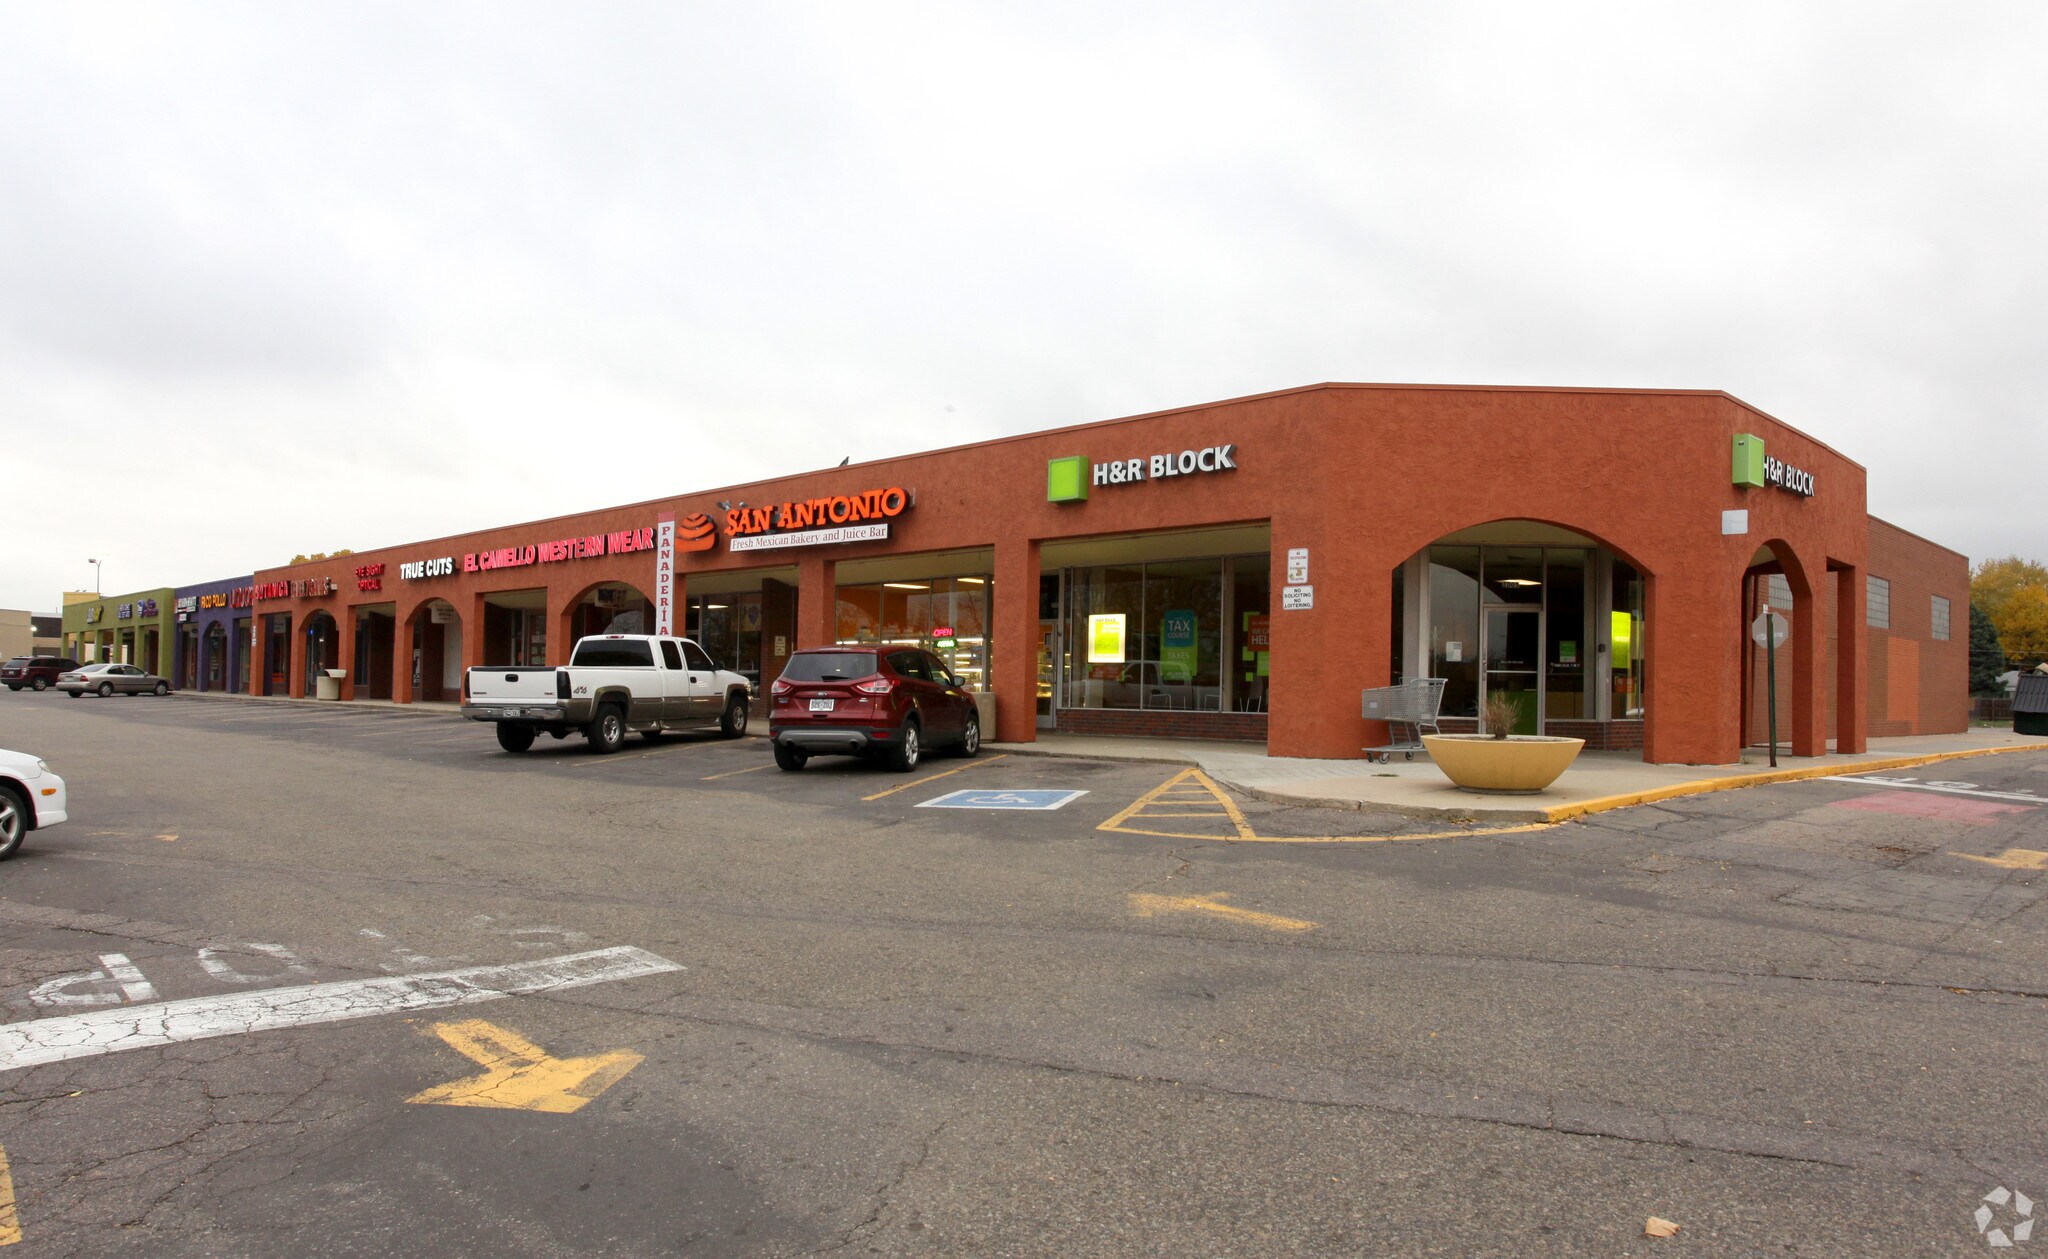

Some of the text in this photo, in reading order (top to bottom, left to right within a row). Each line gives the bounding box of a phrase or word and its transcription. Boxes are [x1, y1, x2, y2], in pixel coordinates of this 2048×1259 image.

[1093, 444, 1236, 486] H&R BLOCK
[1785, 464, 1815, 497] BLOCK
[724, 487, 907, 536] SAN ANTONIO
[732, 526, 886, 549] Fresh Mexican Bakery and Juice Bar
[463, 527, 654, 572] EL CAMELLO WESTERN WEAR
[400, 557, 453, 580] TRUE CUTS
[255, 580, 289, 600] BOTANICA
[933, 627, 953, 637] OPEN
[1167, 631, 1190, 639] COURSE
[1168, 620, 1191, 632] TAX
[1251, 635, 1269, 645] HEL
[1167, 651, 1190, 660] TAXES
